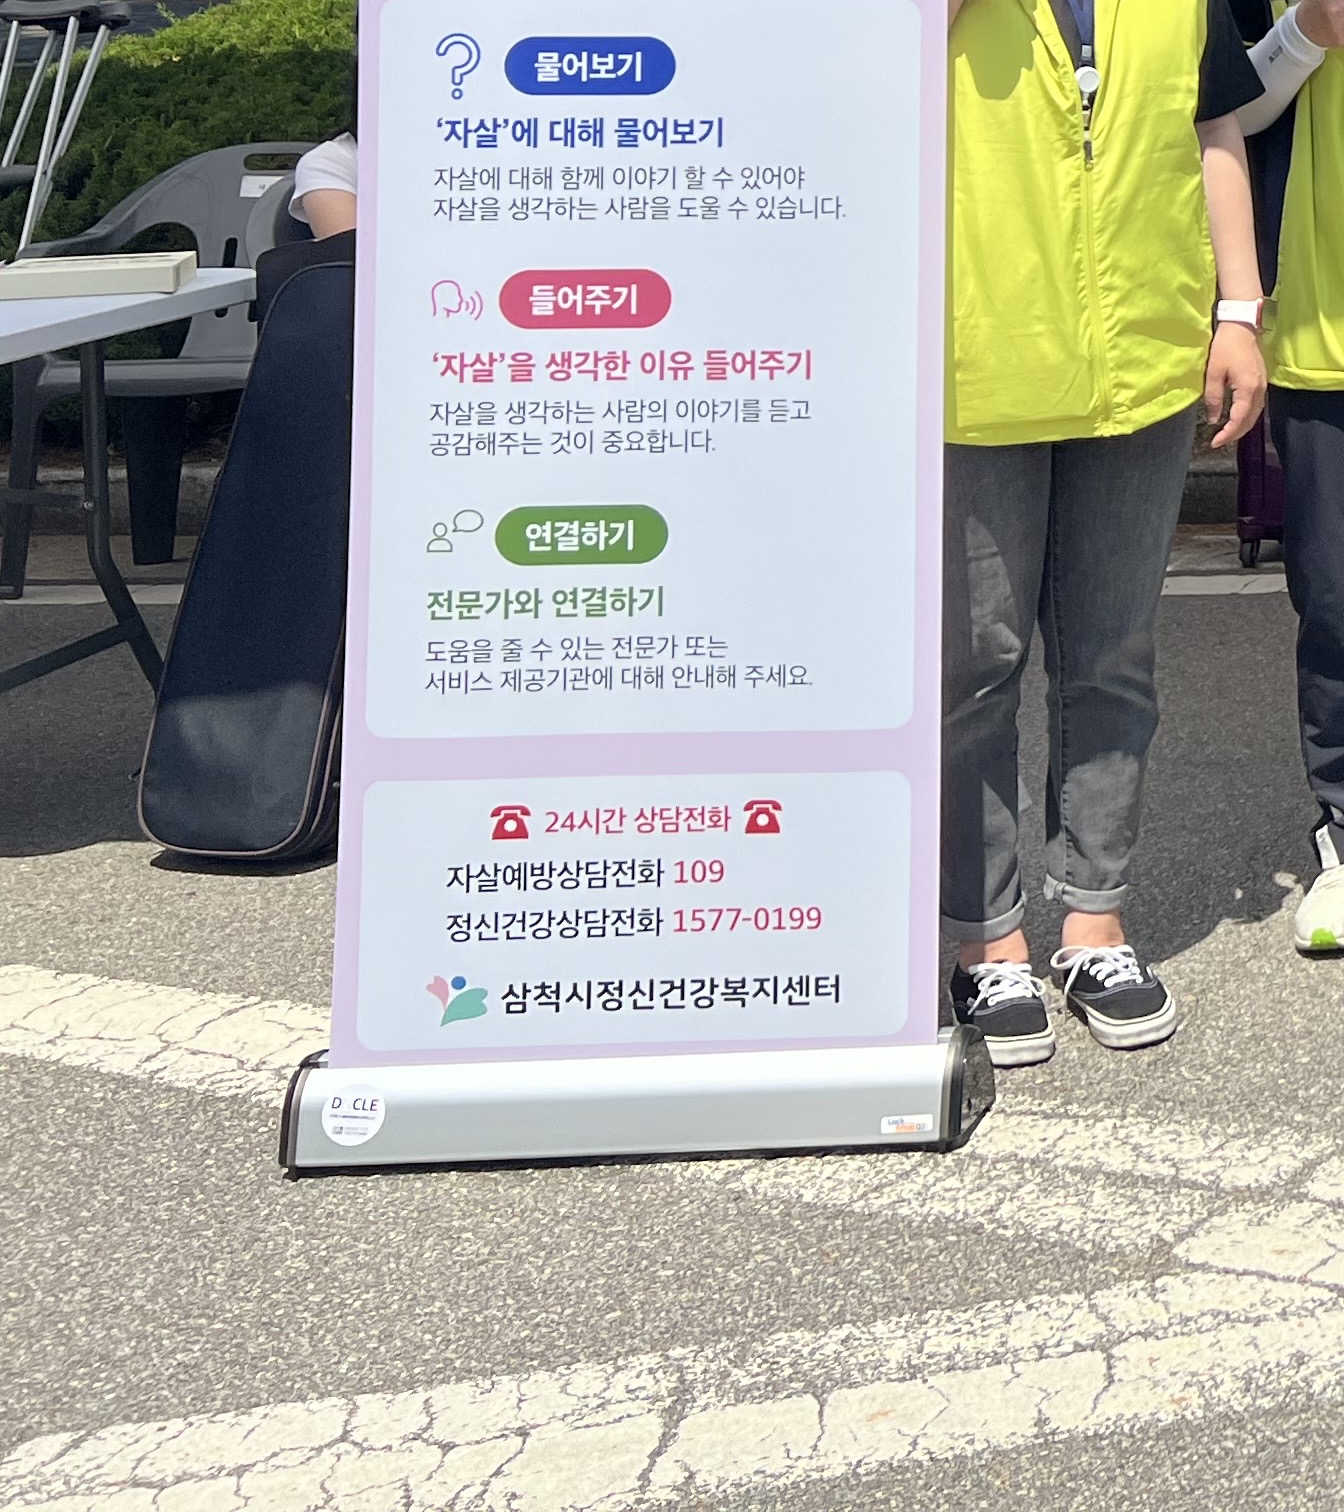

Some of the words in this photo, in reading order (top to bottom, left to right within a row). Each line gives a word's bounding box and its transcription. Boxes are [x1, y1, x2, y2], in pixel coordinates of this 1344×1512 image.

[534, 51, 643, 83] 물어보기
[549, 117, 604, 149] 대해
[614, 116, 724, 149] 물어보기
[433, 166, 501, 191] 자살에
[509, 166, 553, 191] 대해
[561, 166, 605, 190] 함께
[612, 165, 677, 190] 이야기
[684, 165, 706, 190] 할
[712, 165, 732, 190] 수
[740, 164, 806, 190] 있어야
[433, 196, 501, 222] 자살을
[508, 196, 598, 222] 생각하는
[605, 196, 670, 221] 사람을
[677, 196, 719, 221] 도울
[727, 196, 748, 220] 수
[756, 195, 847, 221] 있습니다.
[528, 283, 639, 316] 들어주기
[545, 350, 630, 382] 생각한
[640, 350, 694, 381] 이유
[703, 349, 813, 381] 들어주기
[430, 400, 497, 427] 자살을
[505, 400, 594, 426] 생각하는
[602, 399, 668, 425] 사람의
[675, 399, 762, 425] 이야기를
[769, 399, 811, 424] 듣고
[430, 430, 543, 457] 공감해주는
[550, 430, 594, 455] 것이
[601, 429, 716, 455] 중요합니다.
[525, 518, 635, 553] 연결하기
[425, 588, 542, 622] 전문가와
[551, 585, 665, 620] 연결하기
[425, 636, 494, 664] 도움을
[501, 636, 524, 663] 줄
[530, 635, 553, 662] 수
[560, 635, 605, 662] 있는
[611, 634, 678, 662] 전문가
[686, 634, 728, 660] 또는
[425, 667, 493, 695] 서비스
[500, 665, 613, 694] 제공기관에
[621, 665, 664, 693] 대해
[671, 664, 737, 692] 안내해
[744, 664, 814, 691] 주세요.
[545, 807, 626, 836] 24시간
[635, 805, 732, 835] 상담전화
[445, 857, 664, 893] 자살예방상담전화
[673, 858, 725, 886] 109
[445, 907, 663, 943] 정신건강상담전화
[672, 906, 823, 935] 1577-0199
[500, 972, 842, 1016] 삼척시정신건강복지센터
